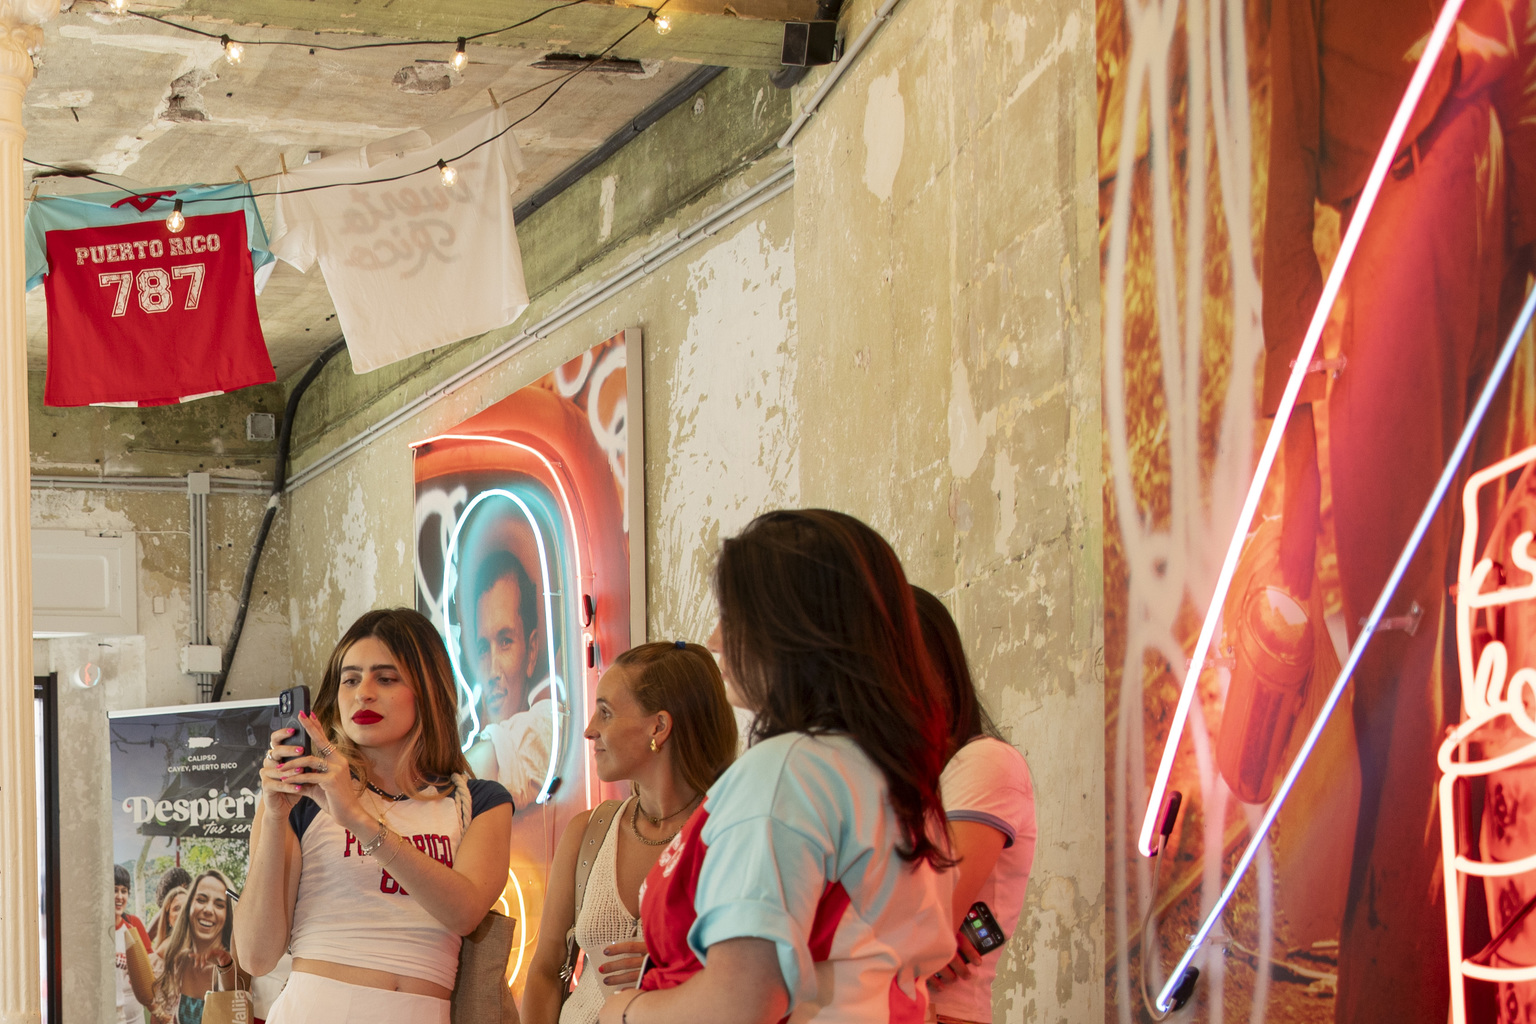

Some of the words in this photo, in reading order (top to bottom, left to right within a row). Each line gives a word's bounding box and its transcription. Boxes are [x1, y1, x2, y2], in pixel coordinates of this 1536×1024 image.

[74, 238, 164, 266] PUERTO
[168, 233, 221, 257] RICO
[98, 262, 206, 318] 787
[187, 754, 217, 762] CALIPSO
[167, 765, 191, 773] CAYEY,
[191, 763, 220, 771] PUERTO
[220, 762, 238, 770] RICO
[203, 821, 227, 835] tus
